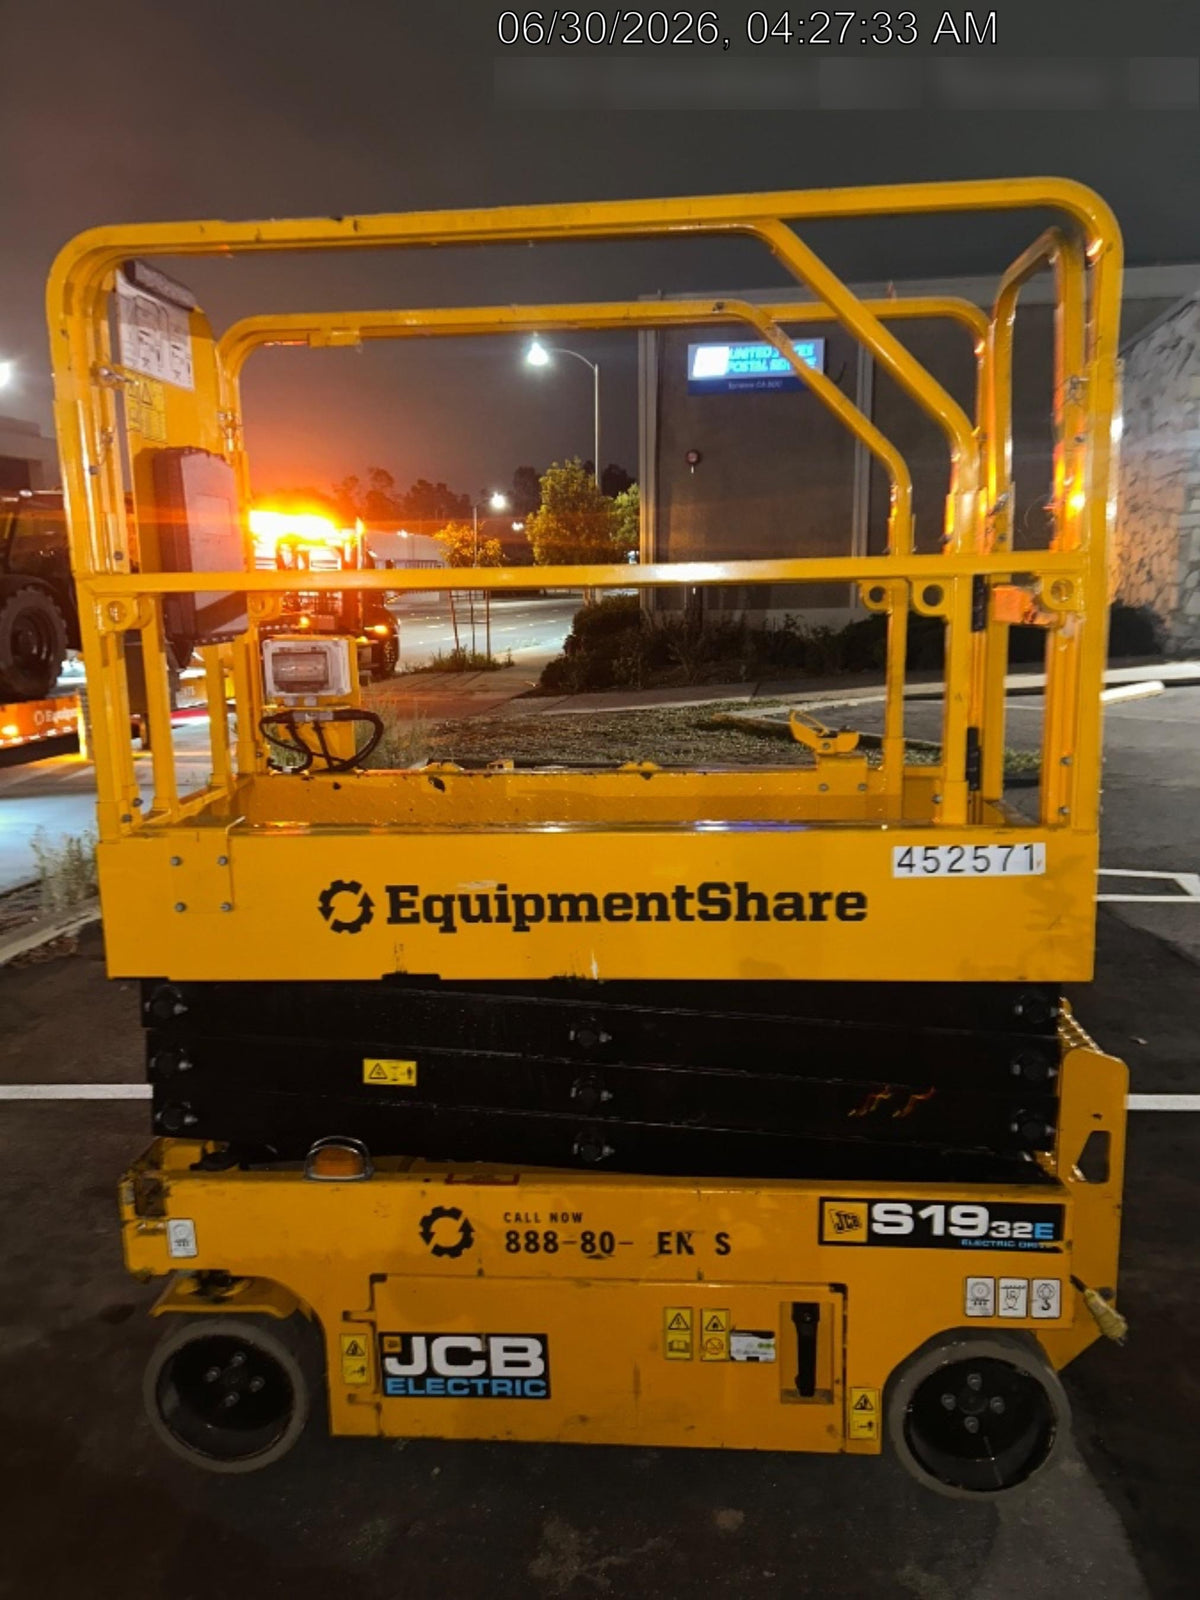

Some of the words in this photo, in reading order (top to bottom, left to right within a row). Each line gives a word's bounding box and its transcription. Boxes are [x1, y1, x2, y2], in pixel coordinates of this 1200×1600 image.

[897, 844, 1034, 873] 452571
[386, 881, 868, 933] EquipmentShare
[504, 1212, 541, 1223] CALL
[550, 1213, 584, 1223] NOW
[961, 1239, 1016, 1248] ELECTRIC
[384, 1336, 545, 1377] JCB
[386, 1378, 547, 1397] ELECTRIC
